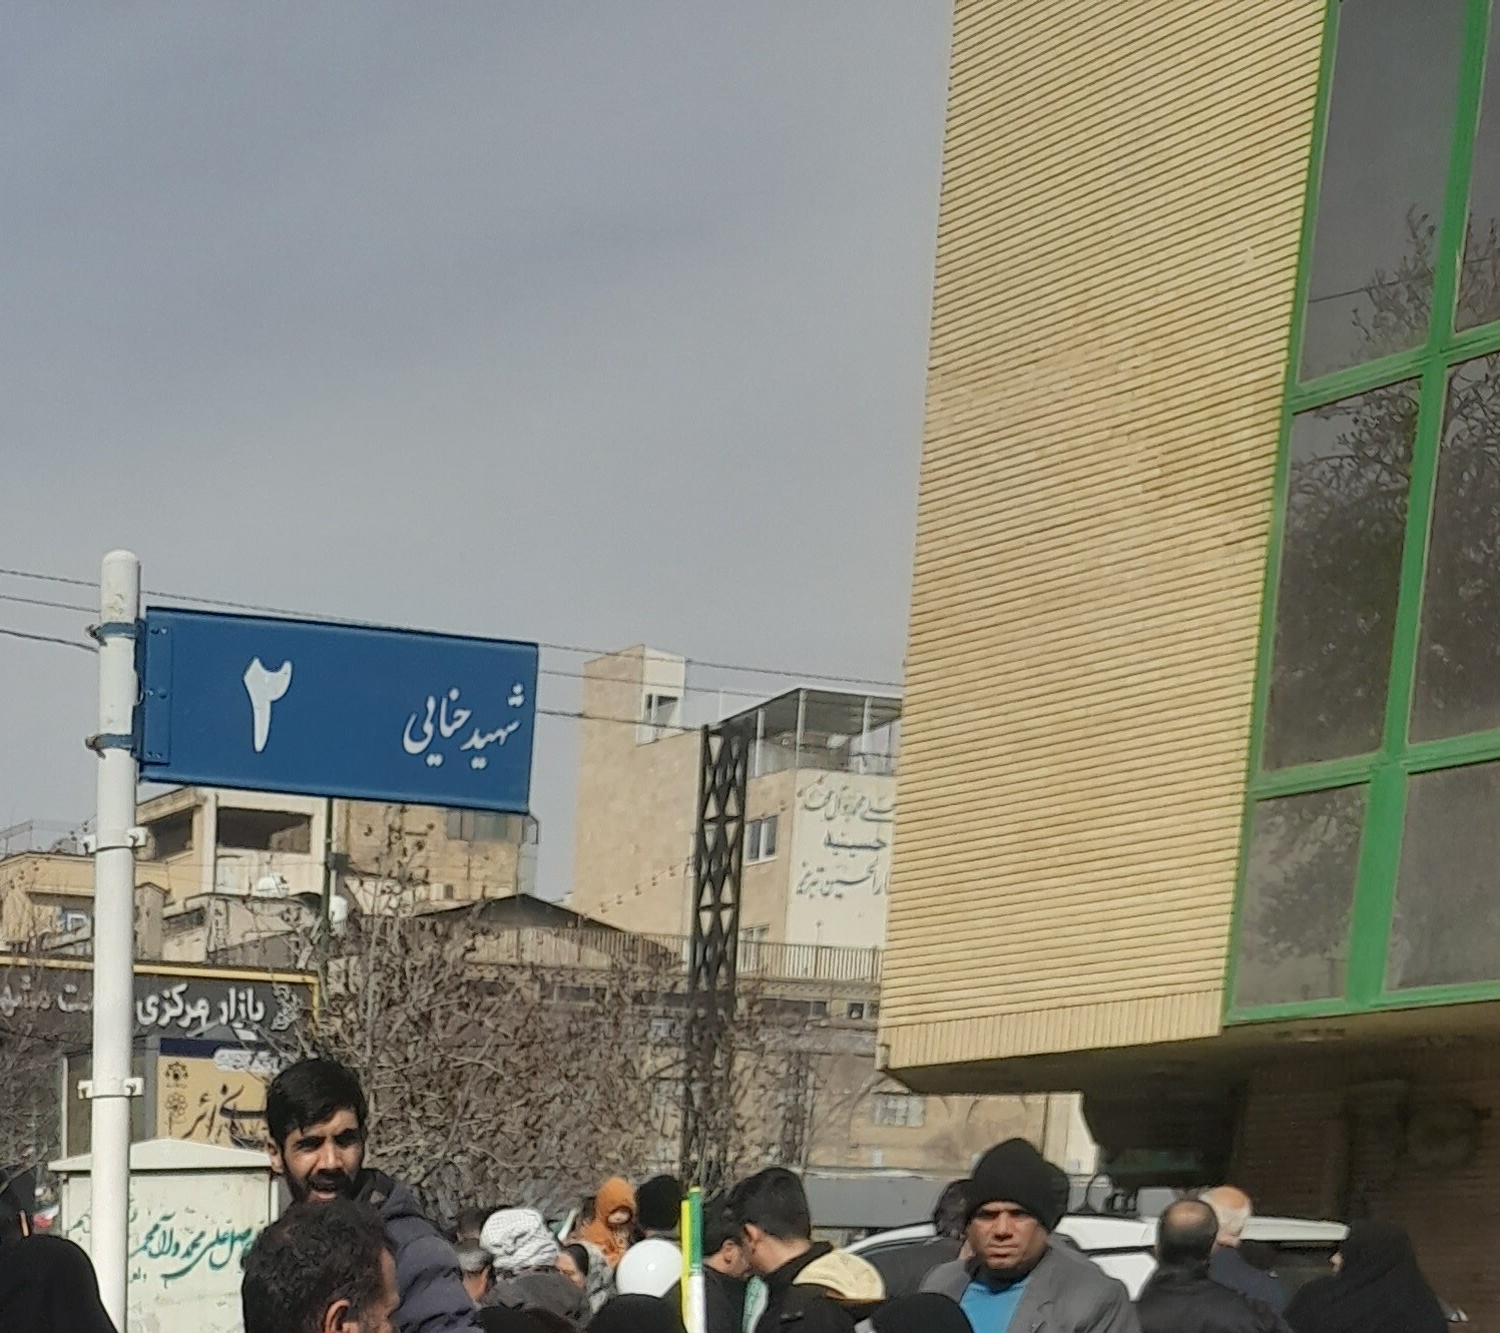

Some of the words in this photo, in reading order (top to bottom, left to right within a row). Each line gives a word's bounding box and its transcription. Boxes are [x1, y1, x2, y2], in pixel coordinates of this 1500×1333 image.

[243, 655, 294, 753] ۲
[459, 681, 525, 770] شهید
[136, 982, 211, 1027] مرکزی
[218, 986, 265, 1027] بازار
